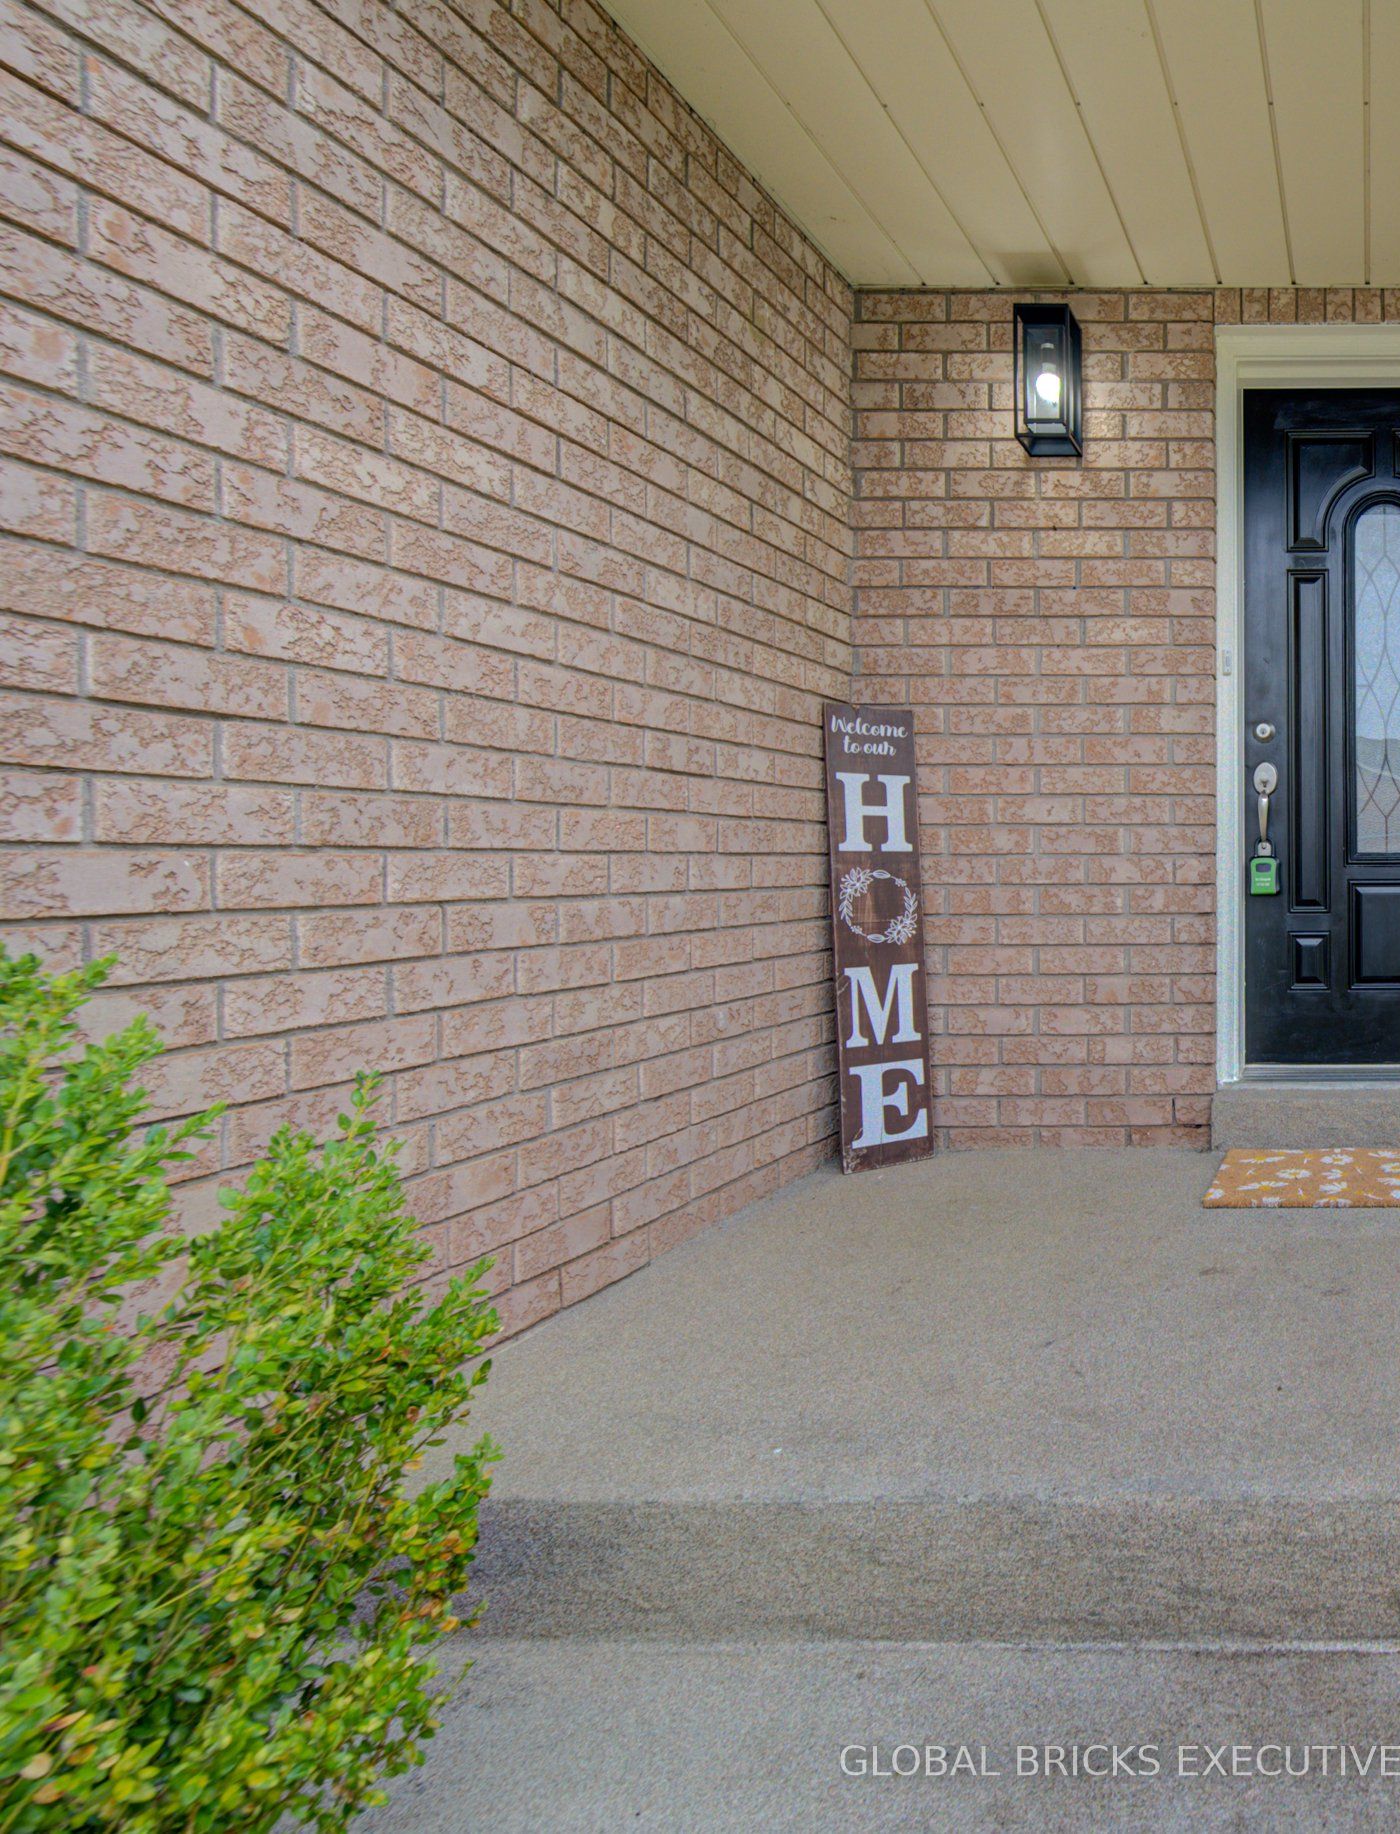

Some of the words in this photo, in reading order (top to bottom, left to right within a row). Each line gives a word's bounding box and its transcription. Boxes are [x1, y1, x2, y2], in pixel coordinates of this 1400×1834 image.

[831, 714, 909, 738] Welcome
[843, 735, 861, 754] to
[863, 741, 897, 756] our
